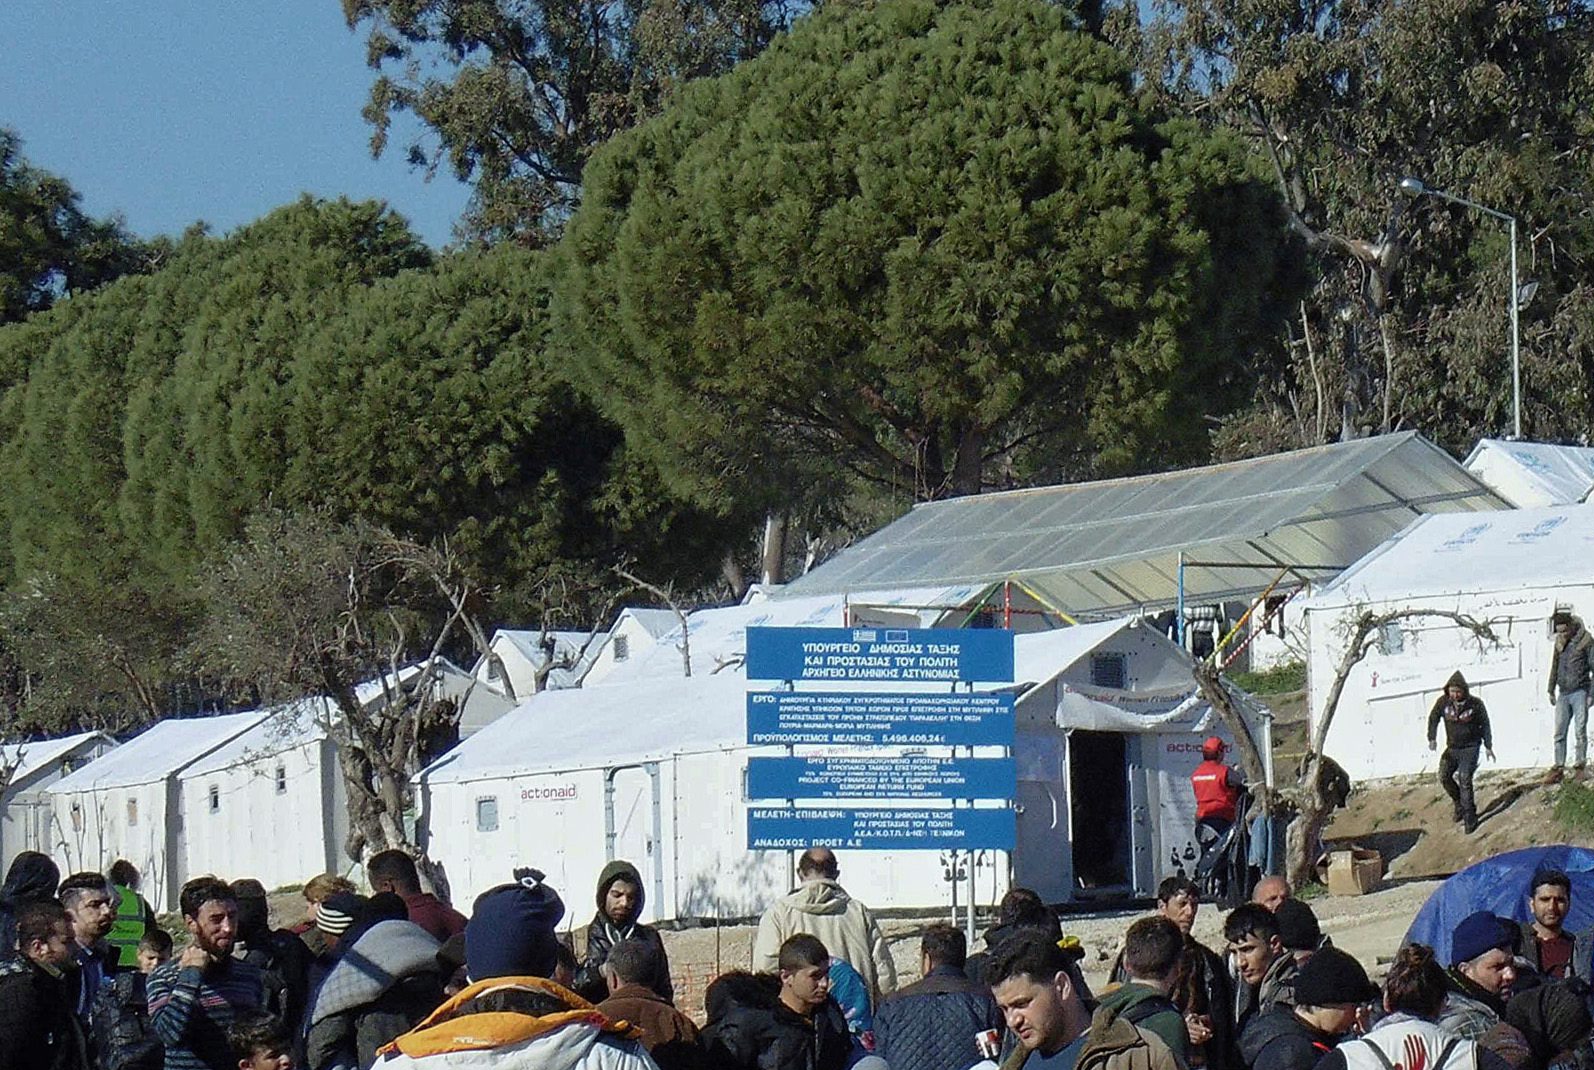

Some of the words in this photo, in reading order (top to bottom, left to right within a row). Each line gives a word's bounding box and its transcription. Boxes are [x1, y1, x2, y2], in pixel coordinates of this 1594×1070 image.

[802, 643, 860, 653] ΥΠΟΥΡΓΕΙΟ
[869, 644, 923, 654] ΔΗΜΟΣΙΑΣ
[927, 644, 960, 654] ΤΑΞΗΣ
[805, 656, 823, 666] ΚΑΙ
[827, 656, 891, 666] ΠΡΟΣΤΑΣΙΑΣ
[895, 657, 915, 666] ΤΟΥ
[919, 657, 958, 666] ΠΟΛΙΤΗ
[802, 668, 846, 677] ΑΡΧΗΓΕΙΟ
[848, 668, 899, 678] ΕΛΛΗΝΙΚΗΣ
[902, 669, 960, 678] ΑΣΤΥΝΟΜΙΑΣ
[753, 695, 776, 703] ΕΡΓΟ:
[754, 838, 807, 847] ΑΝΑΔΟΧΟΣ:
